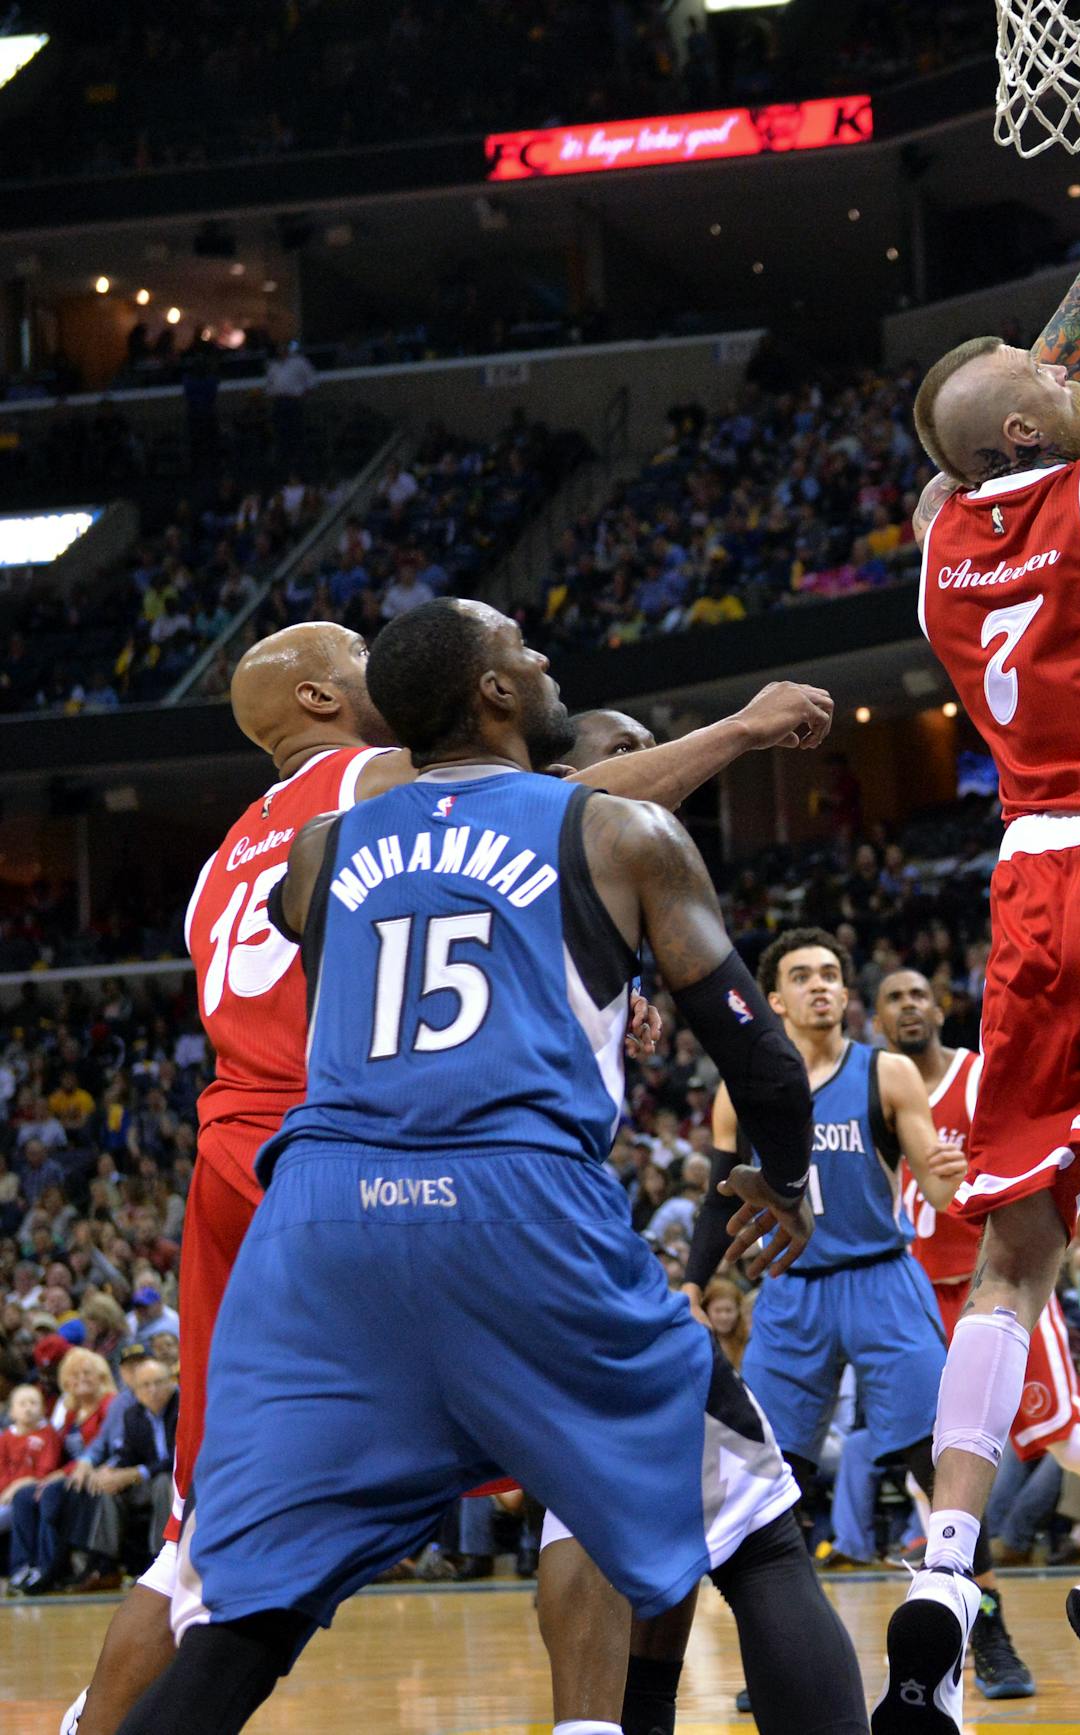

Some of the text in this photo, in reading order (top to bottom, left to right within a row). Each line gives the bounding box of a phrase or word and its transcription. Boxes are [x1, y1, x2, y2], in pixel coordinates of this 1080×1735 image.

[938, 549, 1061, 589] Andersen
[981, 594, 1044, 726] 7
[226, 827, 295, 872] Carter
[330, 826, 558, 912] MUHAMMAD
[203, 861, 300, 1017] 15
[367, 908, 492, 1063] 15
[812, 1119, 866, 1153] SOTA
[360, 1177, 457, 1211] WOLVES
